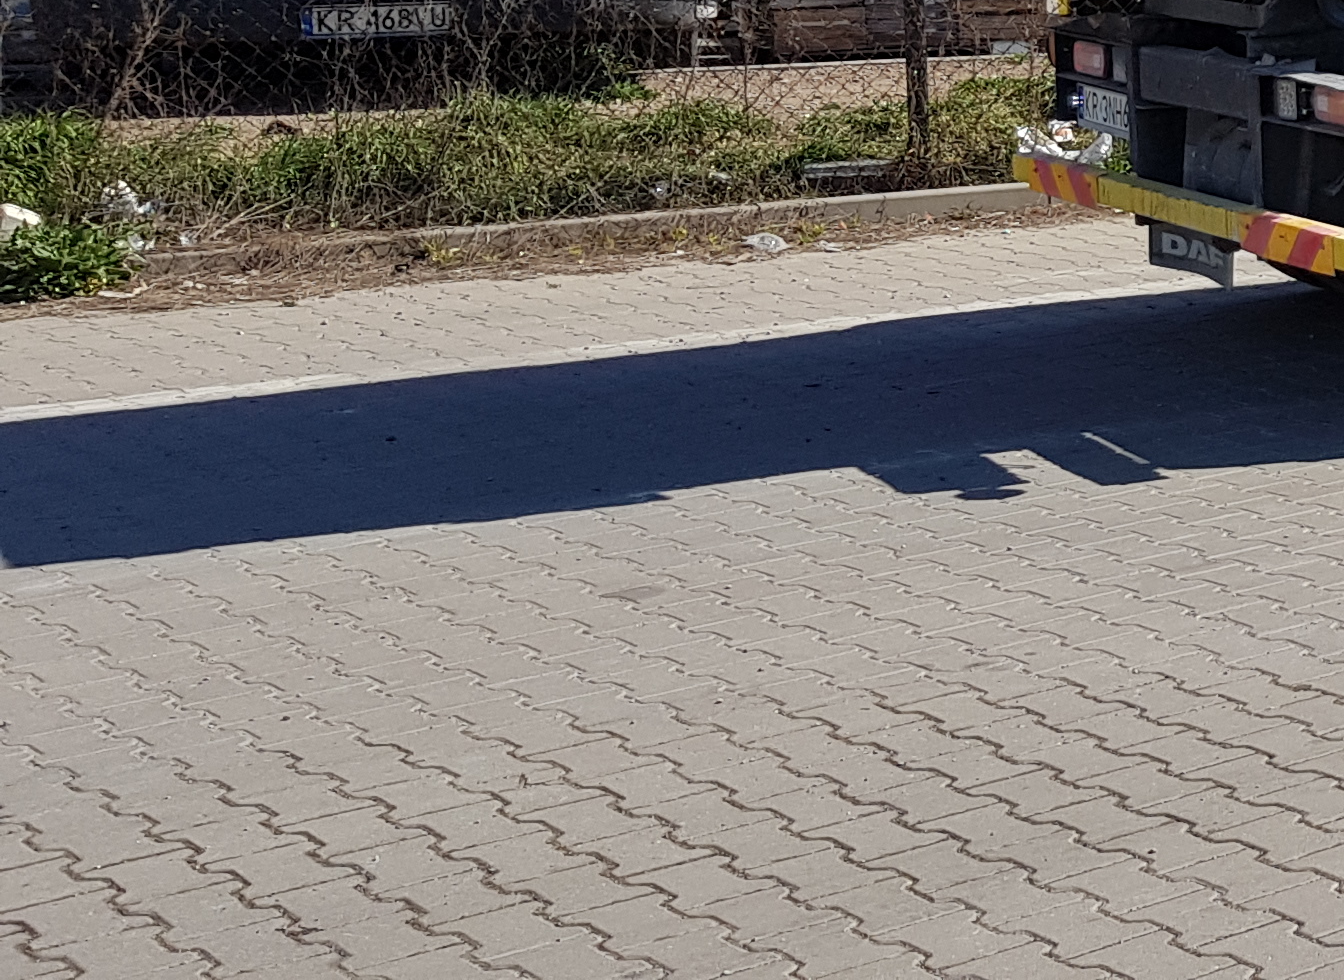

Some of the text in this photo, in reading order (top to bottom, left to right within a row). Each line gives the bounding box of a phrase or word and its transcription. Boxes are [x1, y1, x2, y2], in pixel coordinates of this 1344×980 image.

[317, 9, 355, 33] KR
[1085, 90, 1099, 121] KR
[1161, 232, 1224, 268] DAF
